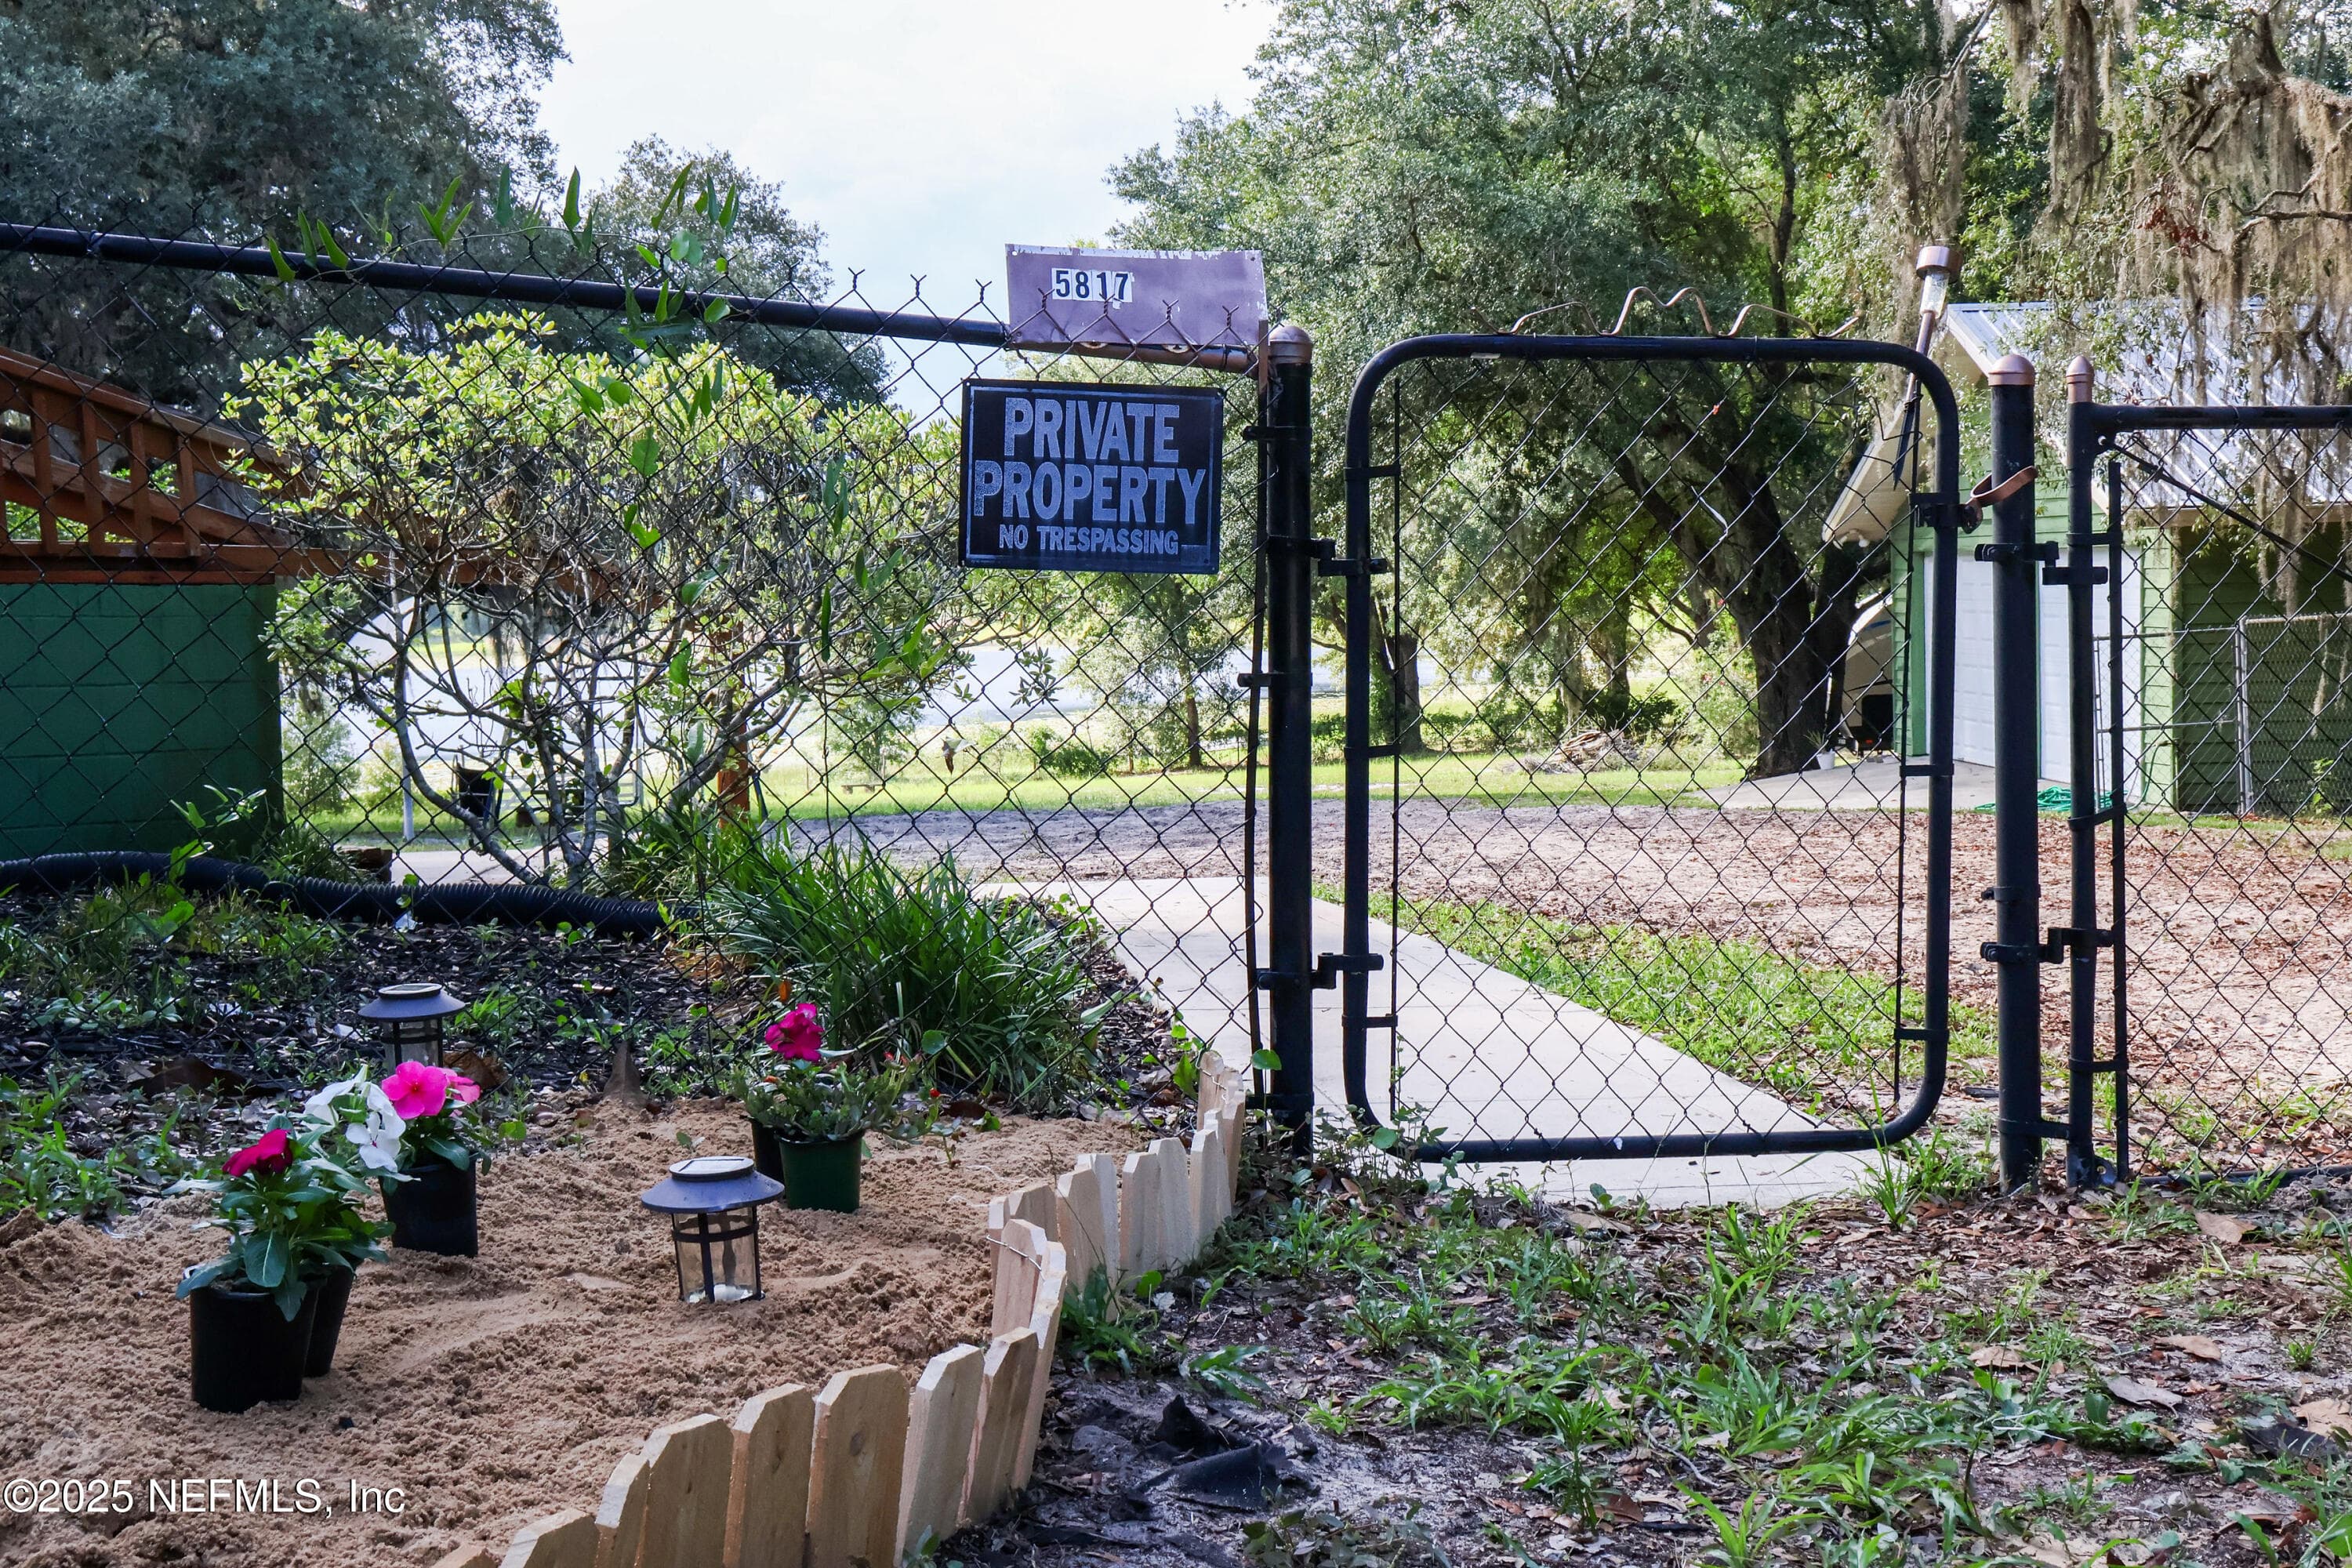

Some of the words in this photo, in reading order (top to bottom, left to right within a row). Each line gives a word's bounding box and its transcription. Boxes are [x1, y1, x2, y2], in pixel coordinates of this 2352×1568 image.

[1054, 270, 1129, 300] 5817
[1004, 397, 1180, 463] PRIVATE
[974, 459, 1206, 525] PROPERTY
[999, 524, 1029, 549] NO
[1036, 525, 1178, 555] TRESPASSING
